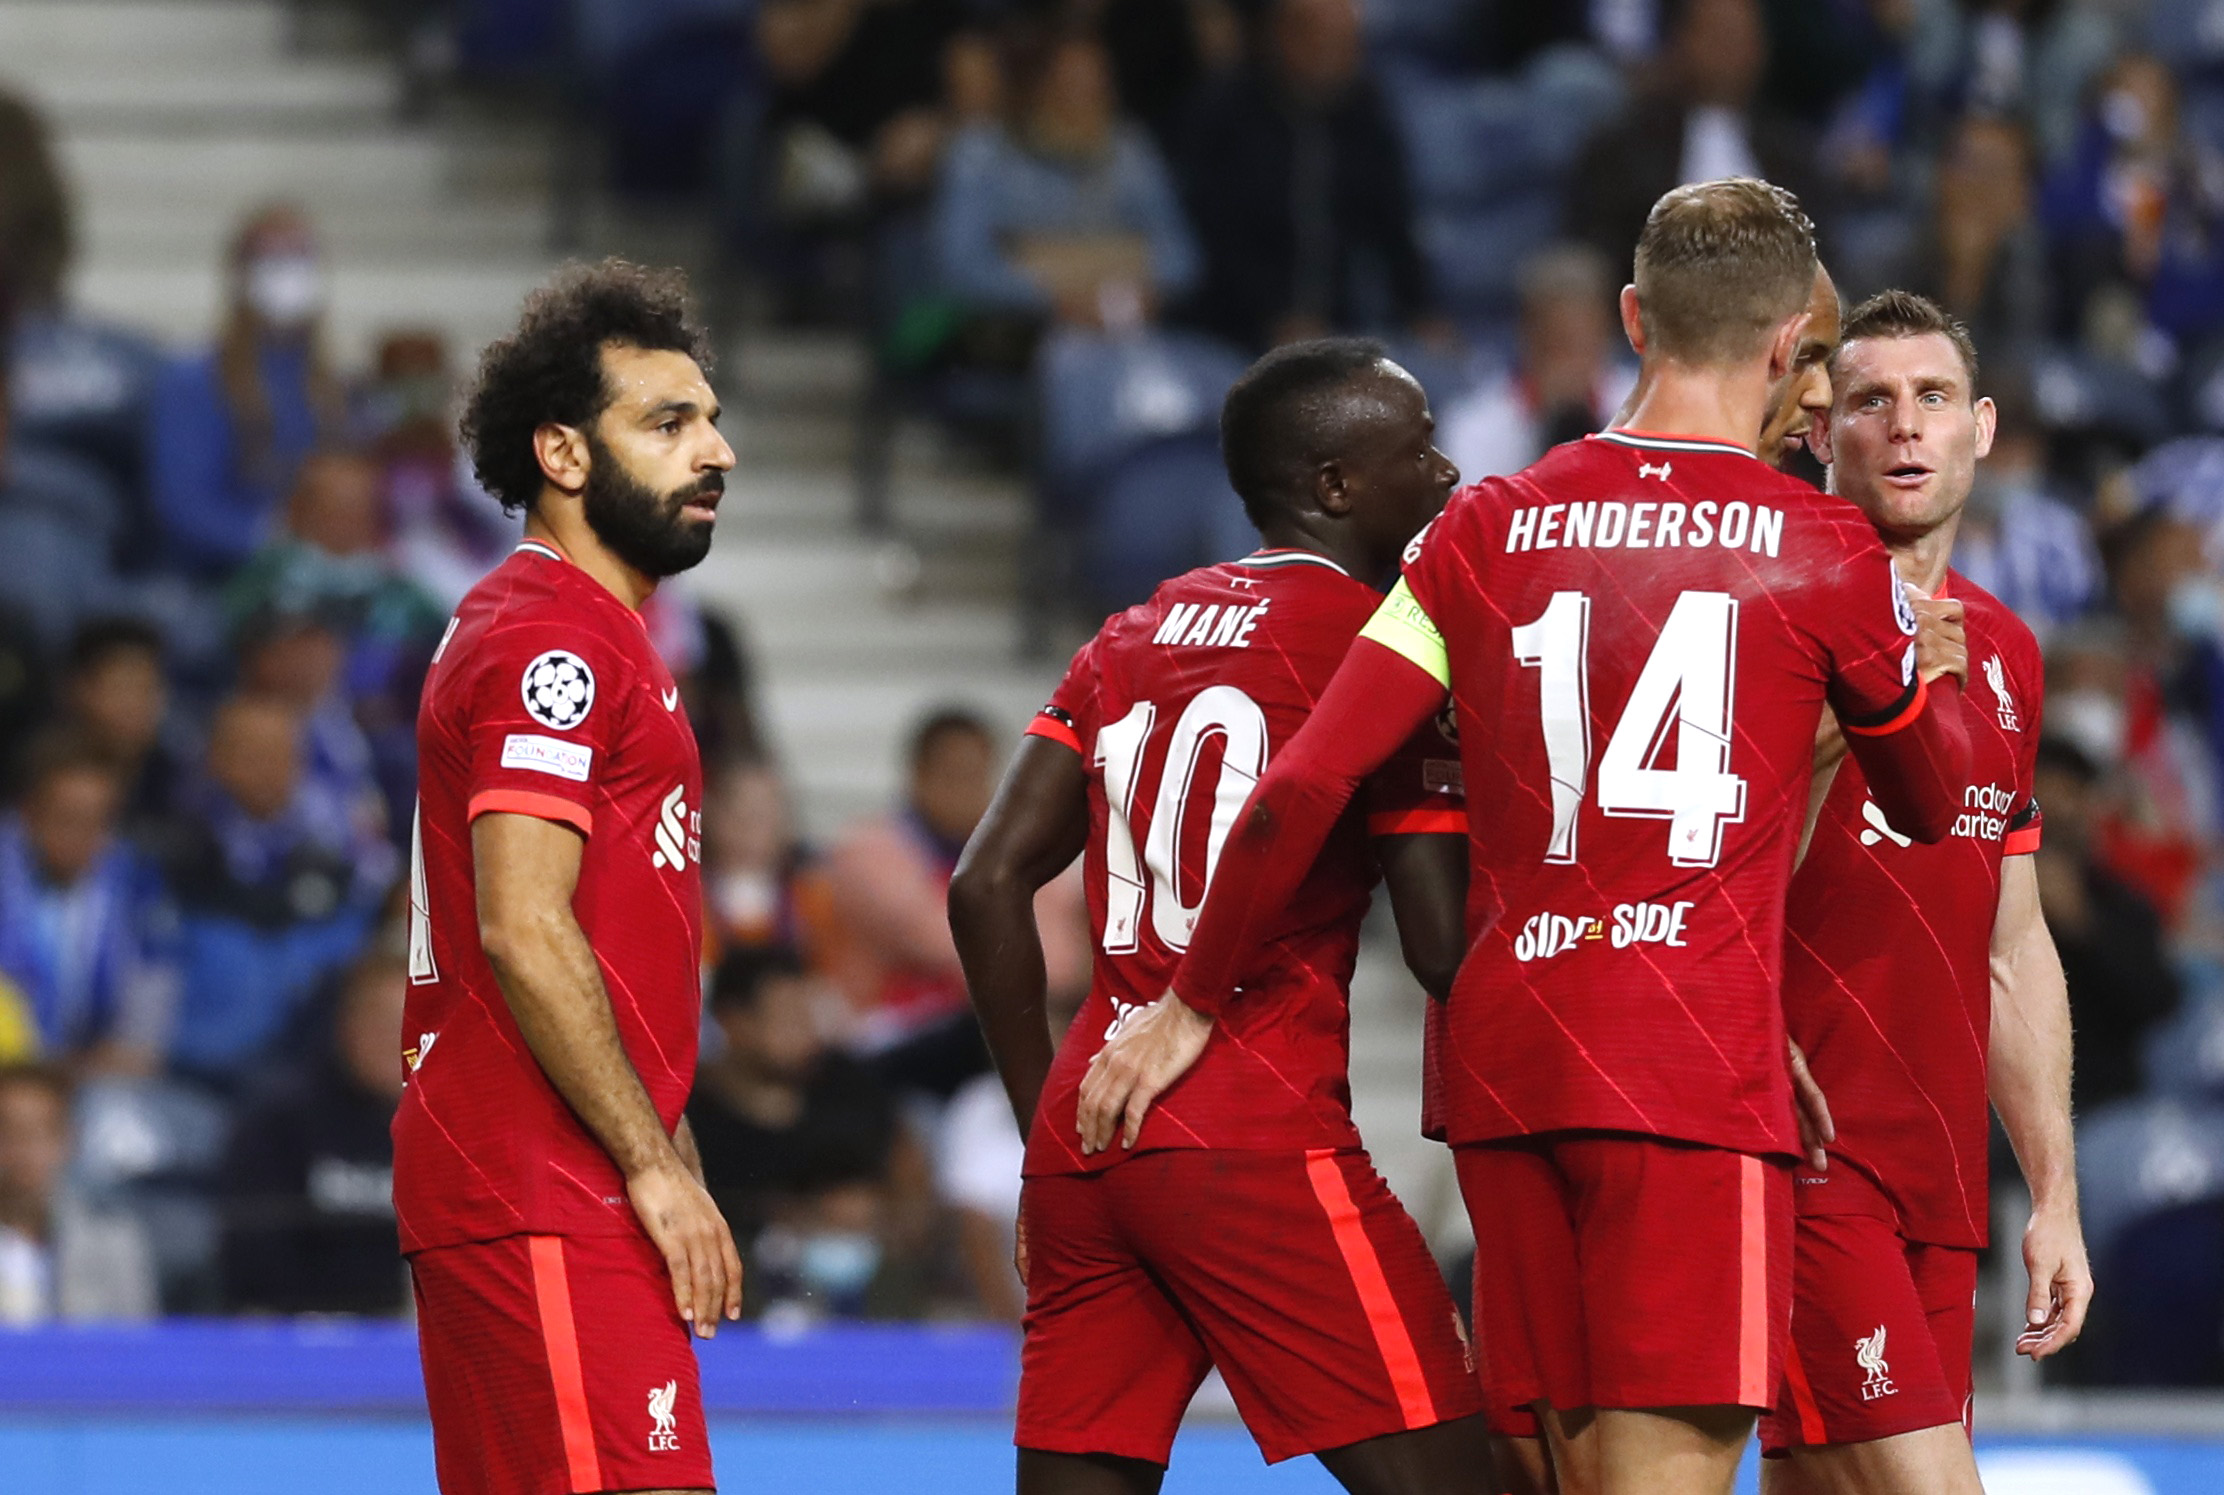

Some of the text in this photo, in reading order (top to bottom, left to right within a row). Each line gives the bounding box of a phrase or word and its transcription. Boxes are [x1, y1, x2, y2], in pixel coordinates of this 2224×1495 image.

[1505, 501, 1783, 558] HENDERSON
[1152, 598, 1271, 648] MANÉ
[1512, 590, 1747, 868] 14
[1093, 685, 1268, 955] 10
[1611, 901, 1694, 948] SIDE
